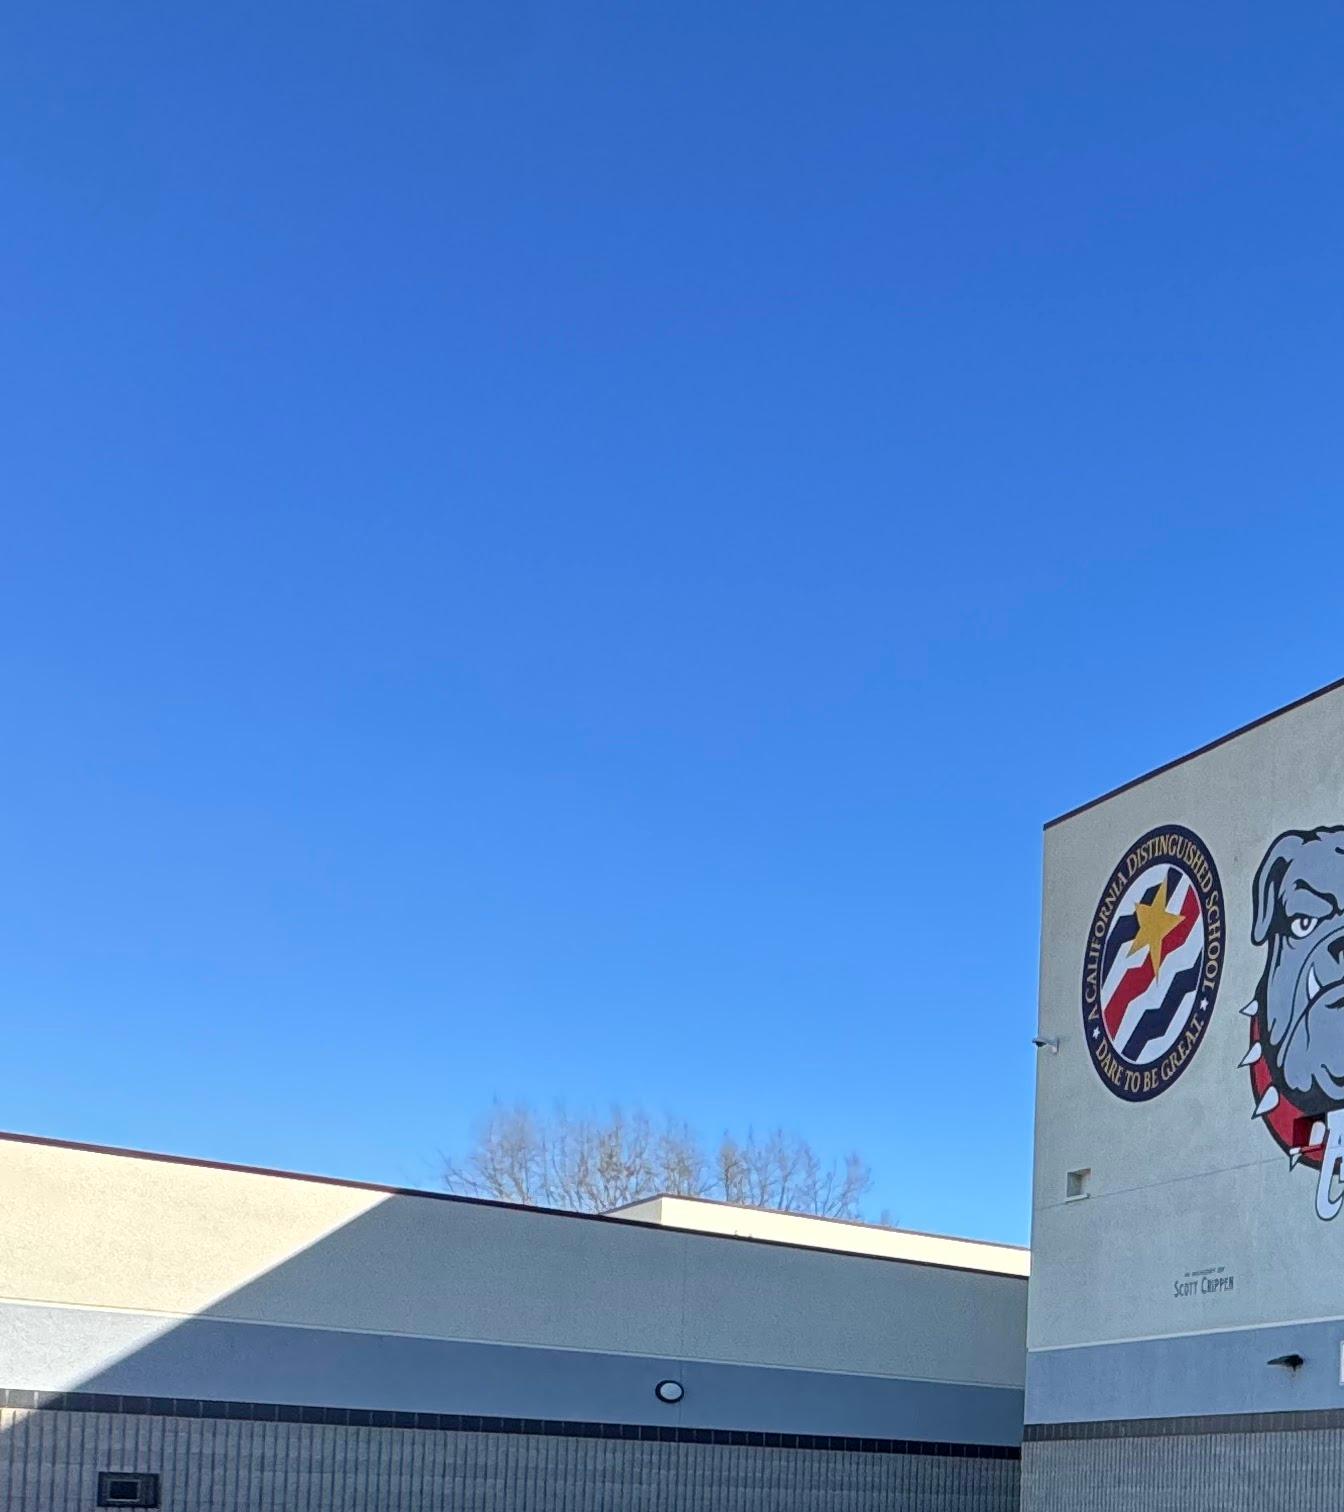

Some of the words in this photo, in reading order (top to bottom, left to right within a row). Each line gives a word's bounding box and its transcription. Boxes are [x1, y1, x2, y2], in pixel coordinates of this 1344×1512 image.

[1084, 871, 1128, 1003] CALIFORNIA
[1126, 833, 1214, 894] DISTINGUISHED
[1204, 890, 1222, 993] SCHOOL
[1095, 1038, 1124, 1087] DARE
[1122, 1071, 1142, 1094] TO
[1143, 1068, 1159, 1093] BE
